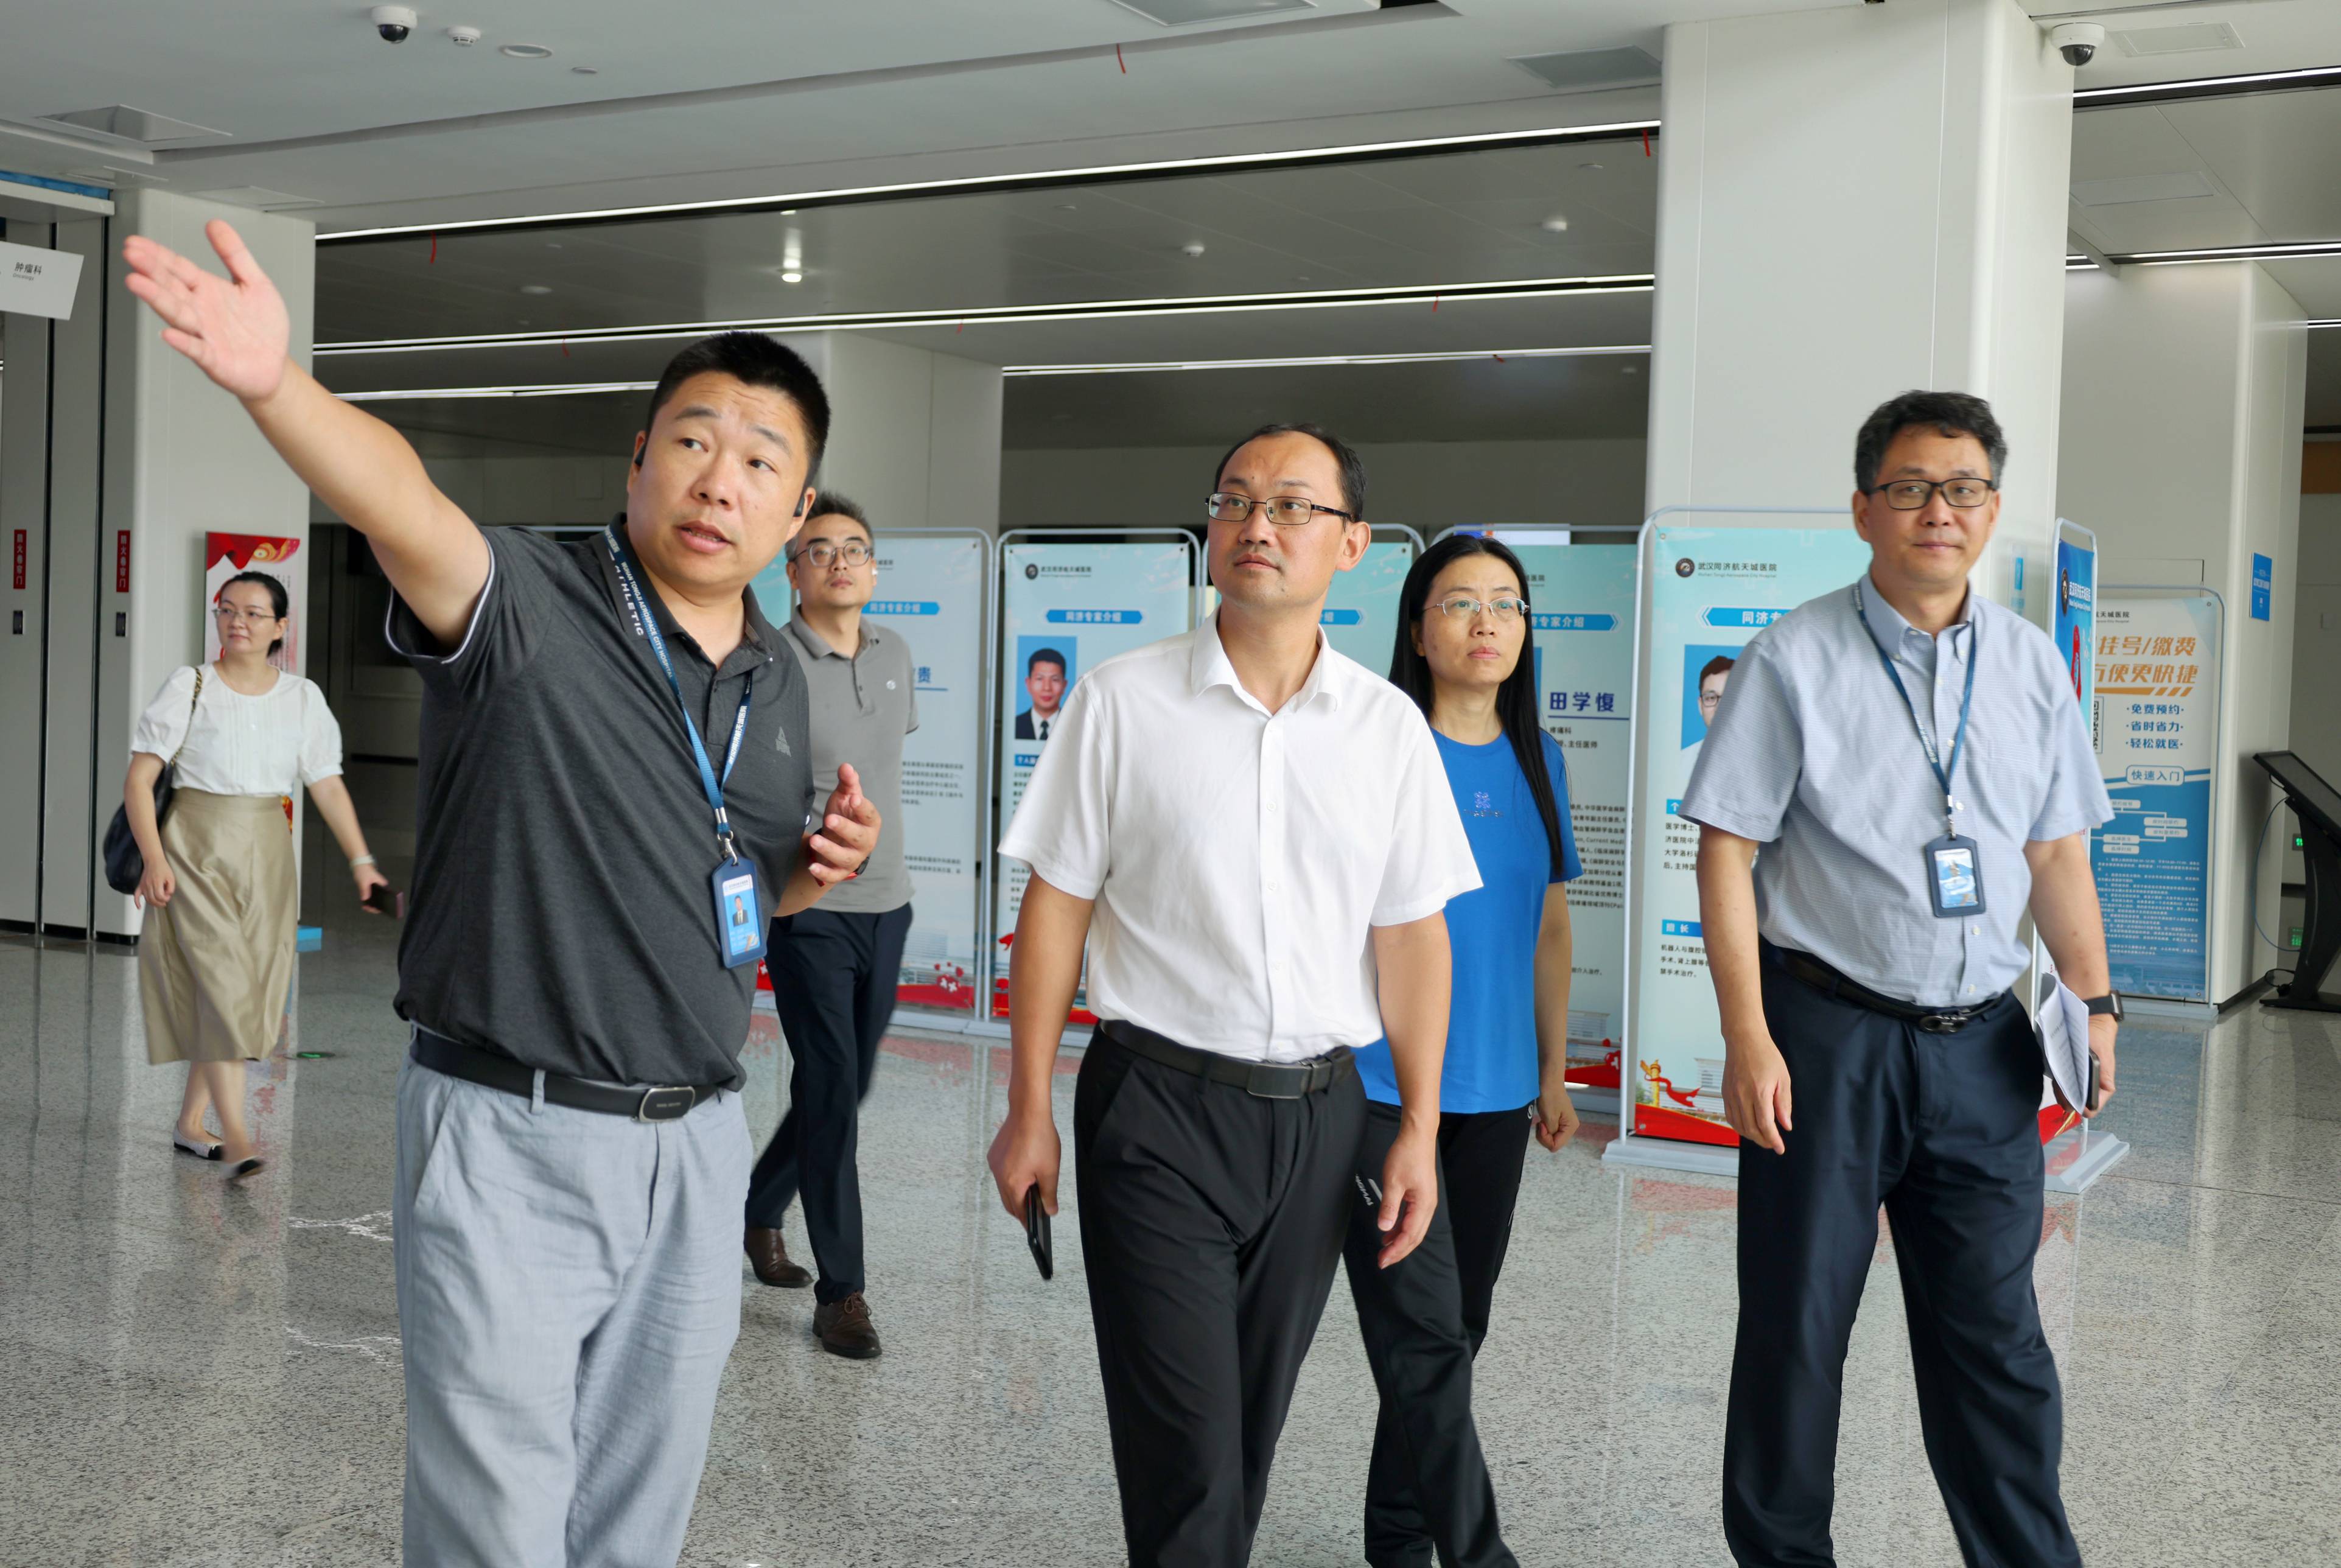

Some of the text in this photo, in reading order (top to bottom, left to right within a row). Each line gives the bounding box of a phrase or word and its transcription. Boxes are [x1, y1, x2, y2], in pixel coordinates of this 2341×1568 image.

[15, 262, 42, 275] 肿瘤科
[1698, 562, 1777, 571] 武汉同济航天城医院
[621, 561, 634, 581] WUHAN
[630, 580, 643, 601] TONGJI
[639, 601, 657, 636] AEROSPACE
[653, 636, 663, 649] CITY
[1066, 611, 1122, 622] 同济专家介绍
[2099, 635, 2196, 656] 挂号/缴费
[2132, 769, 2180, 782] 快速入门
